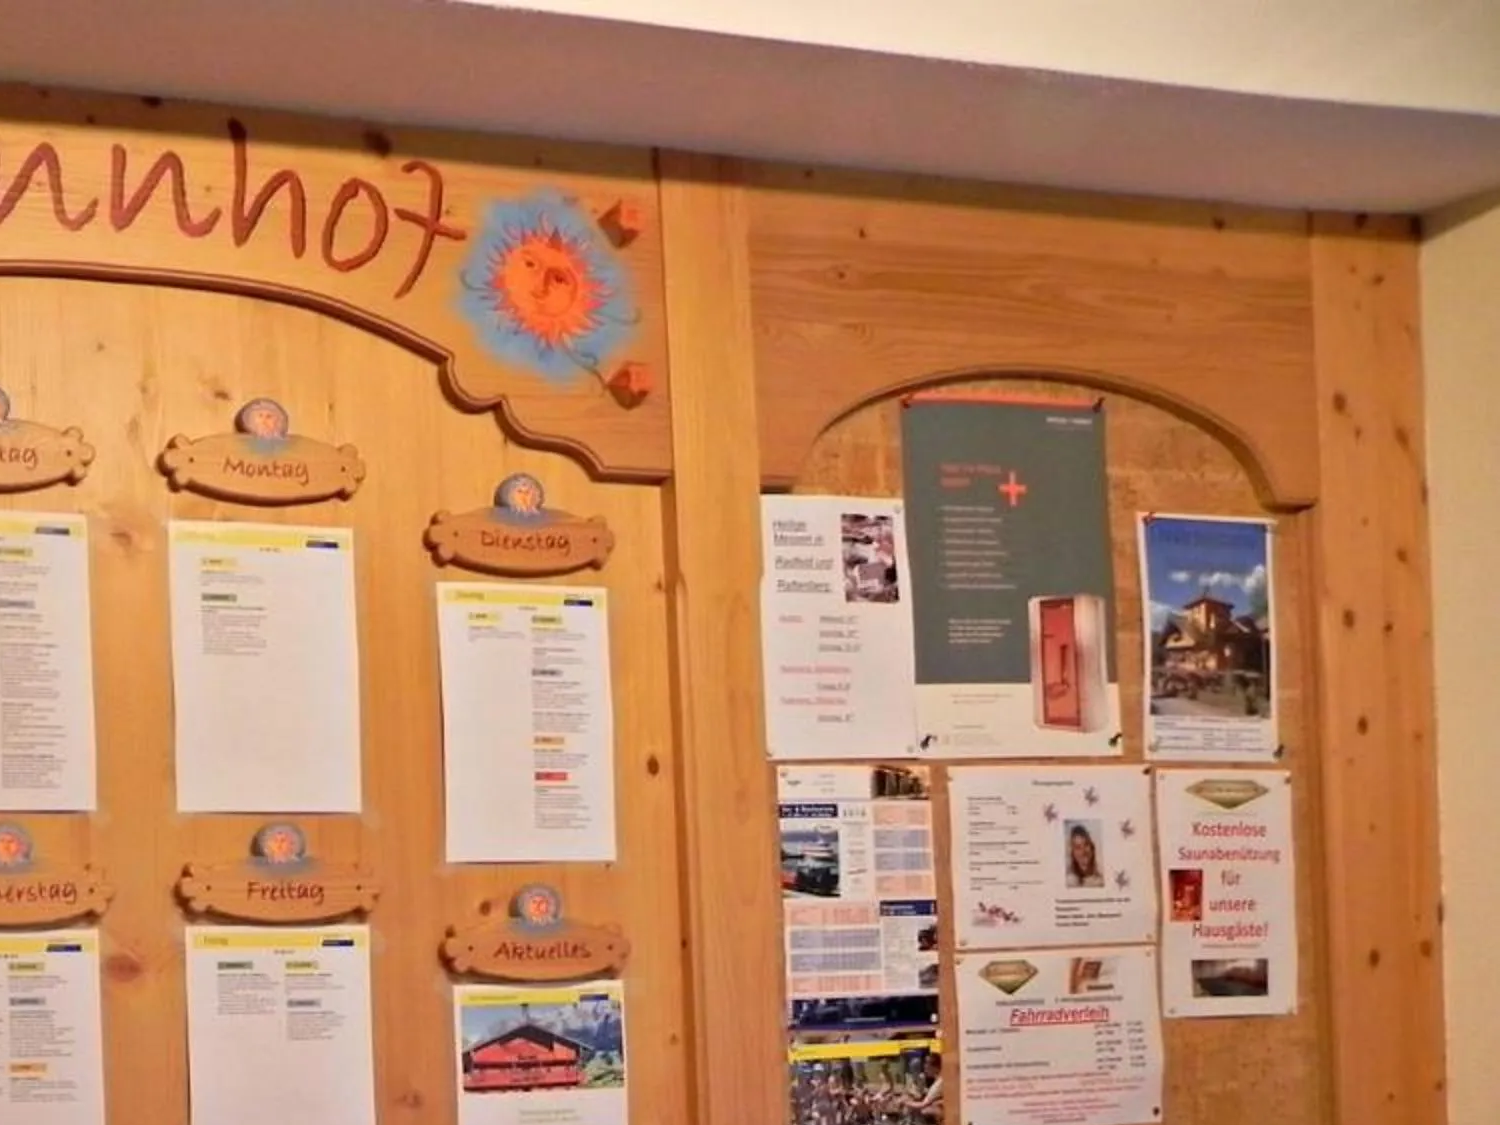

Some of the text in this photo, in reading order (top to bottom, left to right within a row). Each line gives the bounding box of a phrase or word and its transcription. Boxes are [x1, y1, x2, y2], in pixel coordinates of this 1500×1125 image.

[222, 456, 309, 485] Montag
[480, 530, 571, 555] Dienstag
[1192, 820, 1267, 838] Kostenlose
[246, 880, 325, 903] Freitag
[1209, 900, 1257, 912] unsere
[492, 940, 592, 961] Aktuelles
[1010, 1007, 1110, 1024] Fahrradverleih
